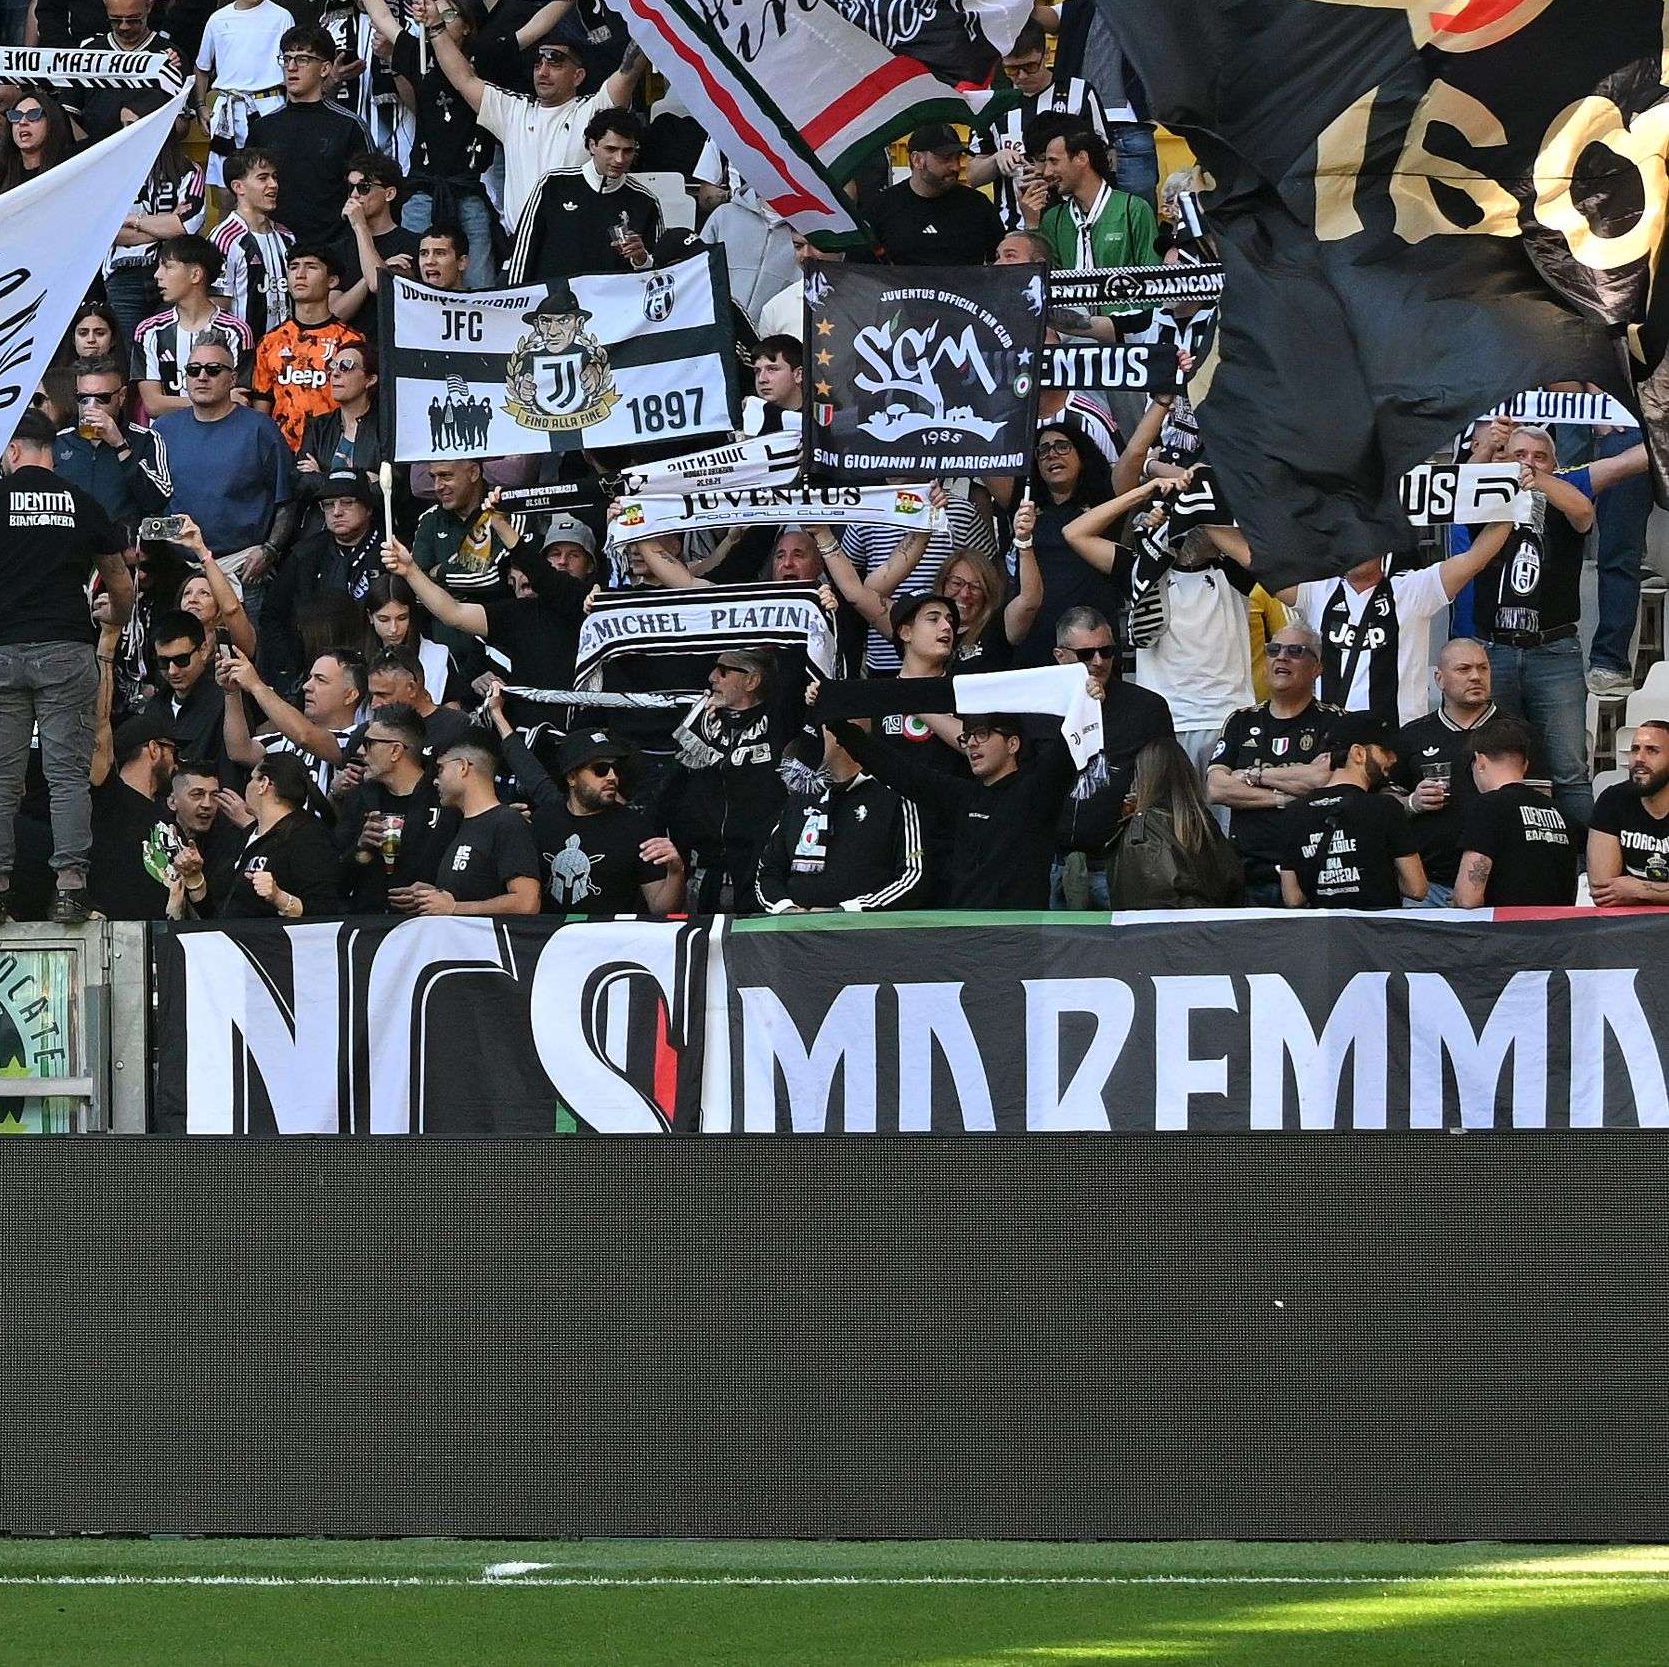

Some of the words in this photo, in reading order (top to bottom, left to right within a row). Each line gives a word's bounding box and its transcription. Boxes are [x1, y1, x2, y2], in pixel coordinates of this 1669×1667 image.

[441, 310, 484, 343] JFC
[880, 289, 935, 304] JUVENTUS
[938, 290, 980, 312] OFFICIAL
[978, 306, 998, 326] FAN
[993, 322, 1014, 350] CLUB
[854, 321, 997, 393] SGM
[278, 367, 326, 387] Jeep
[525, 414, 550, 430] FINO
[552, 416, 576, 430] ALLA
[578, 409, 603, 427] FINE
[625, 387, 705, 436] 1897
[921, 431, 963, 446] 1985
[814, 452, 839, 468] SAN
[844, 454, 915, 469] GIOVANNI
[919, 454, 935, 469] IN
[939, 454, 1024, 469] MARIGNANO
[680, 486, 862, 519] JUVENTUS
[595, 612, 686, 637] MICHEL
[711, 604, 815, 632] PLATINI
[739, 972, 1668, 1131] MAREMMA
